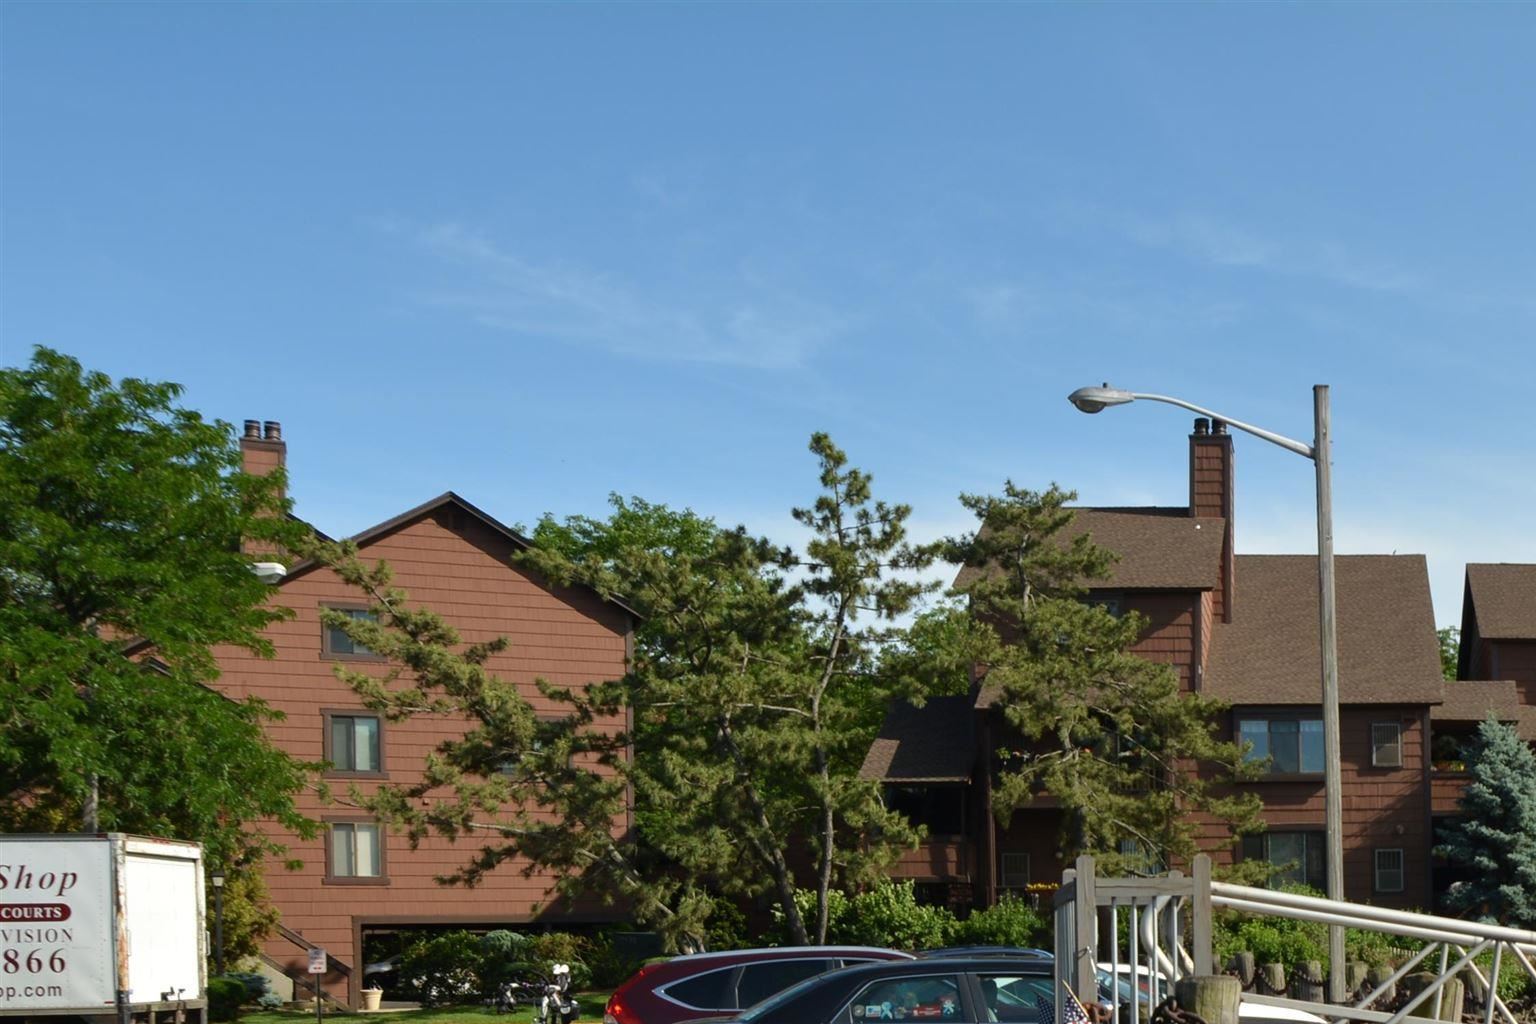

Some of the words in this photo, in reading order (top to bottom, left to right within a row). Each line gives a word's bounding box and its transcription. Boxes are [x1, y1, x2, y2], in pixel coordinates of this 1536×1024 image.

[0, 864, 78, 897] Shop
[1, 907, 62, 918] COURTS
[0, 928, 73, 943] VISION
[3, 948, 66, 974] 866
